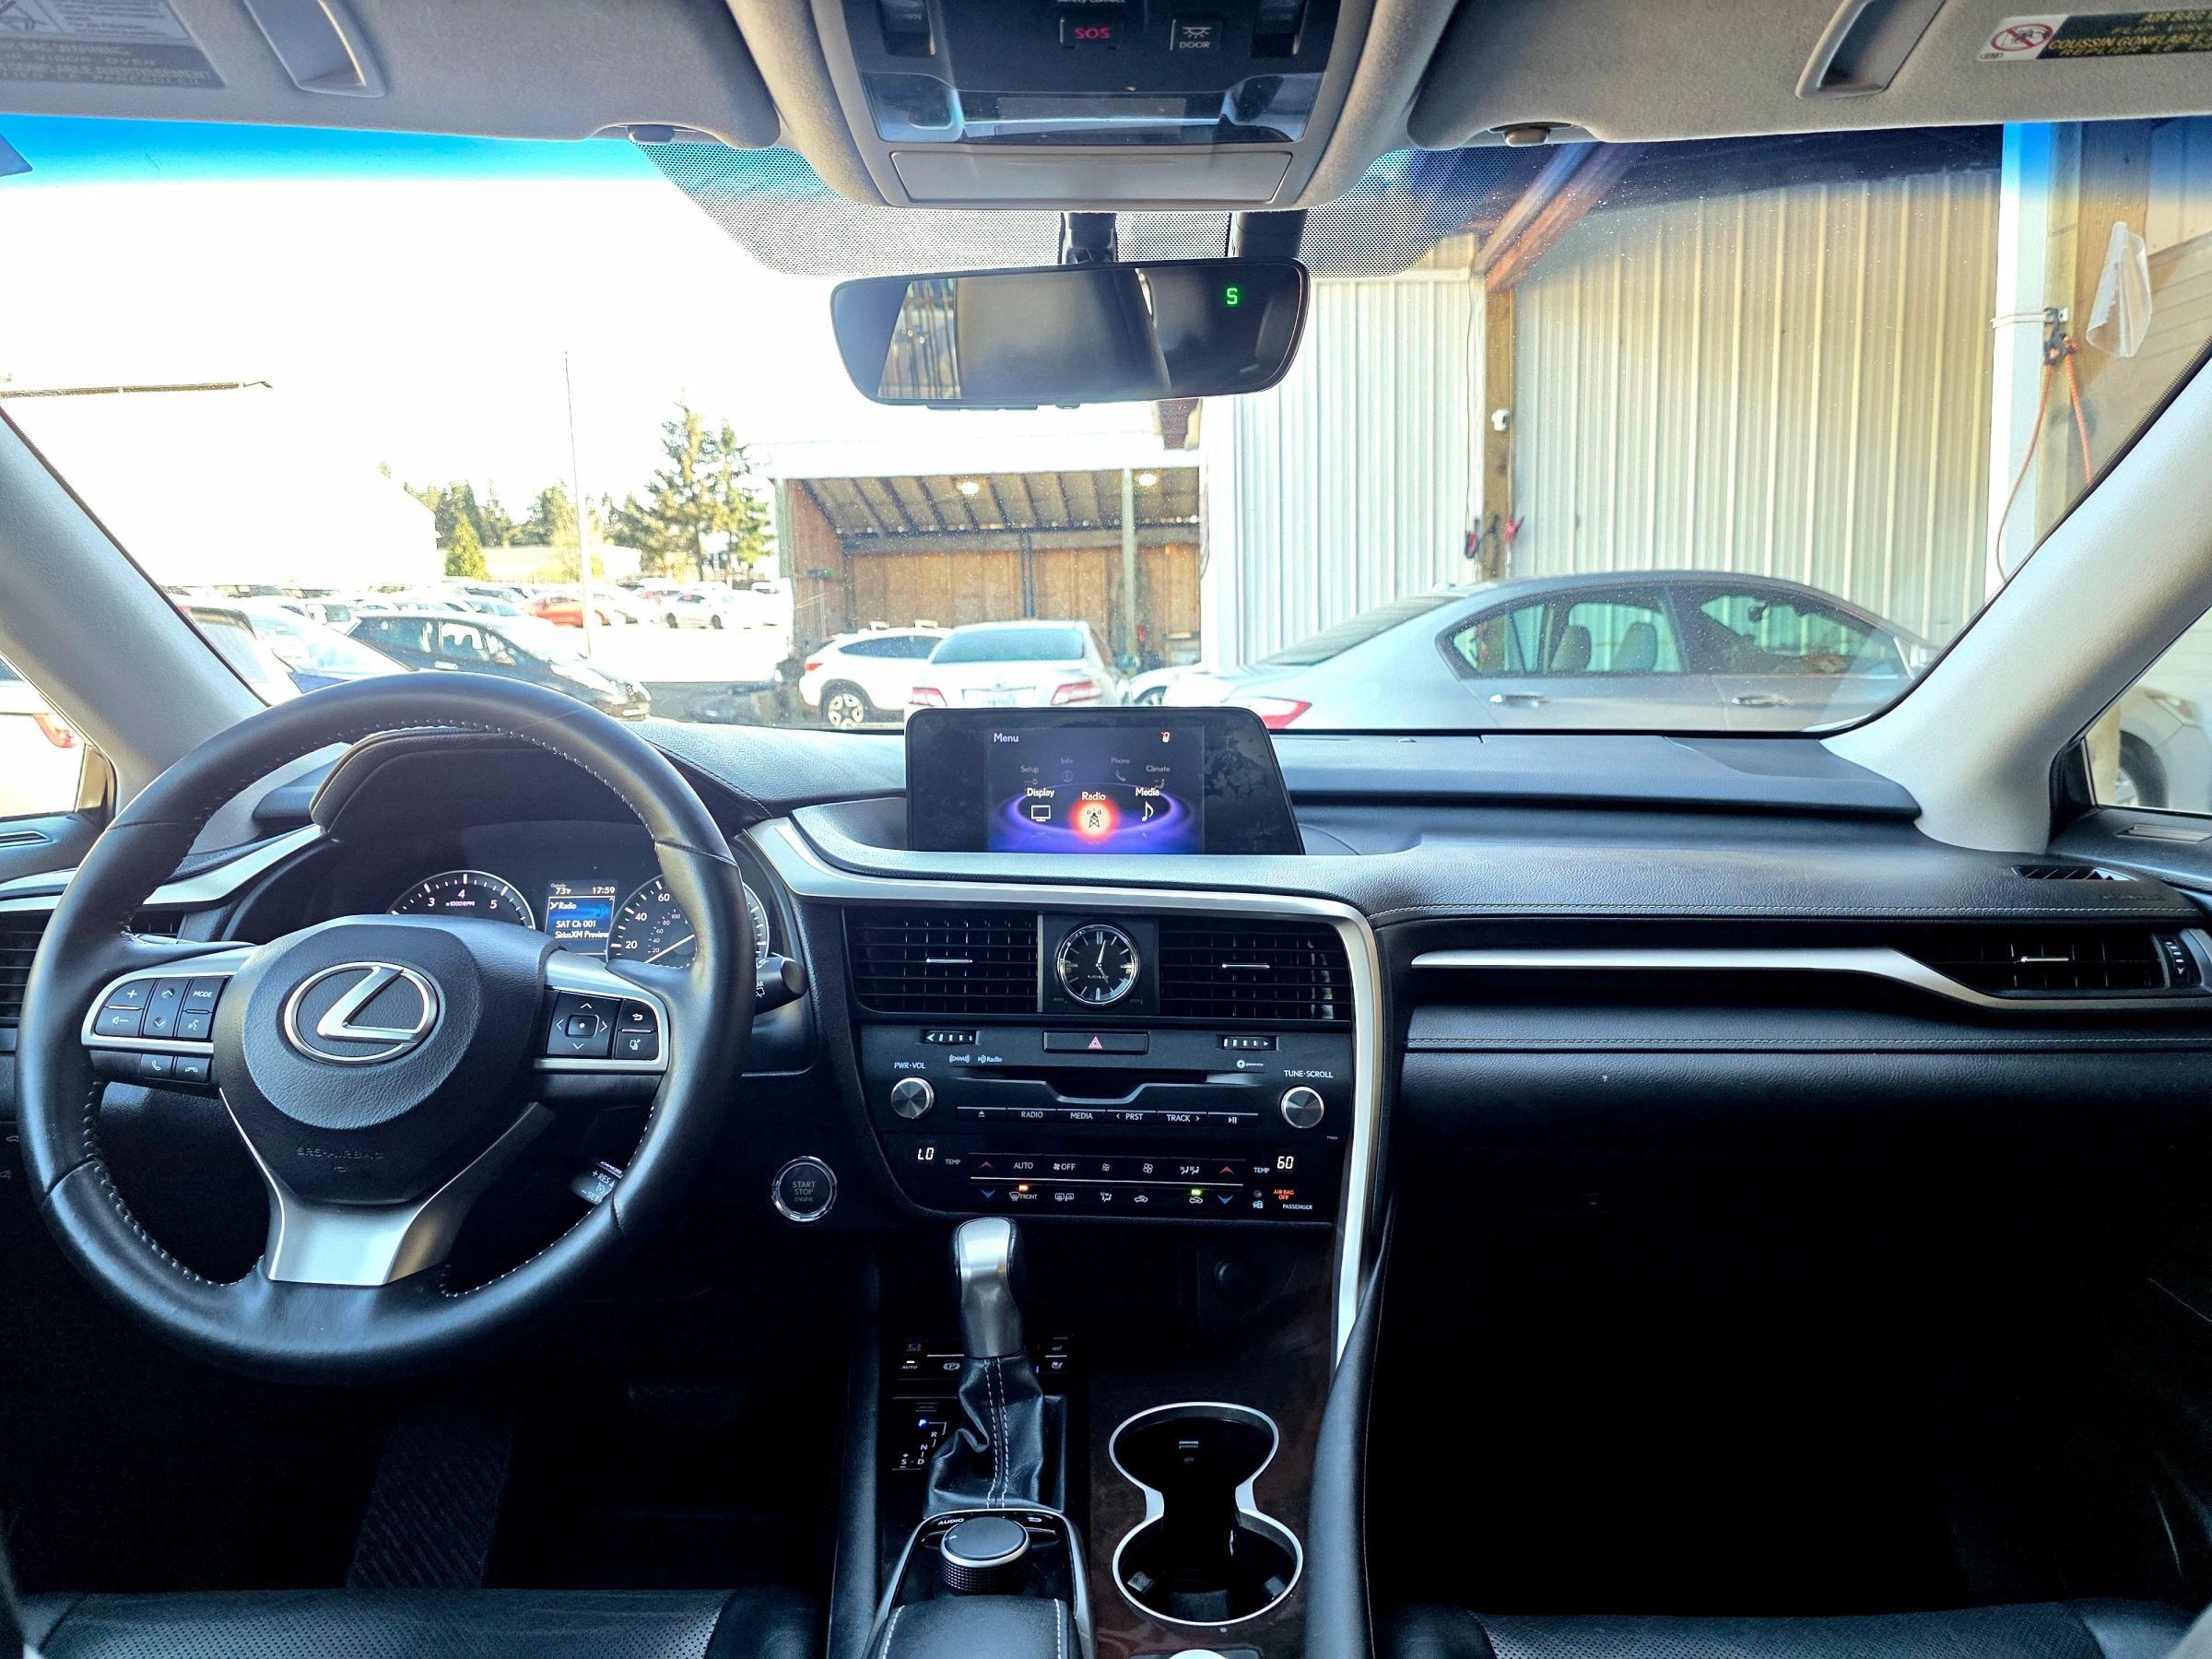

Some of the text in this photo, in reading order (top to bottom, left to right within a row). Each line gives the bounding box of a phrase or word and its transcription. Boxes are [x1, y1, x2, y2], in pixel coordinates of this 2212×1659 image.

[1075, 27, 1111, 40] SOS
[1180, 41, 1210, 49] DOOR
[1227, 288, 1238, 305] S
[994, 733, 1019, 743] Menu
[1060, 757, 1074, 765] Info
[1111, 757, 1130, 765] Phone
[1020, 765, 1040, 774] Setup
[1146, 765, 1171, 773] Climate
[1026, 788, 1055, 799] Display
[1081, 792, 1106, 801] Radio
[1135, 787, 1160, 797] Media
[457, 889, 465, 899] 4
[658, 893, 670, 901] 60
[428, 898, 435, 907] 3
[489, 900, 498, 909] 5
[635, 912, 647, 921] 40
[1021, 1111, 1043, 1119] RADIO
[1167, 1114, 1191, 1123] TRACK
[1277, 1156, 1294, 1169] 60
[597, 1172, 611, 1184] RES
[586, 1191, 600, 1202] SET
